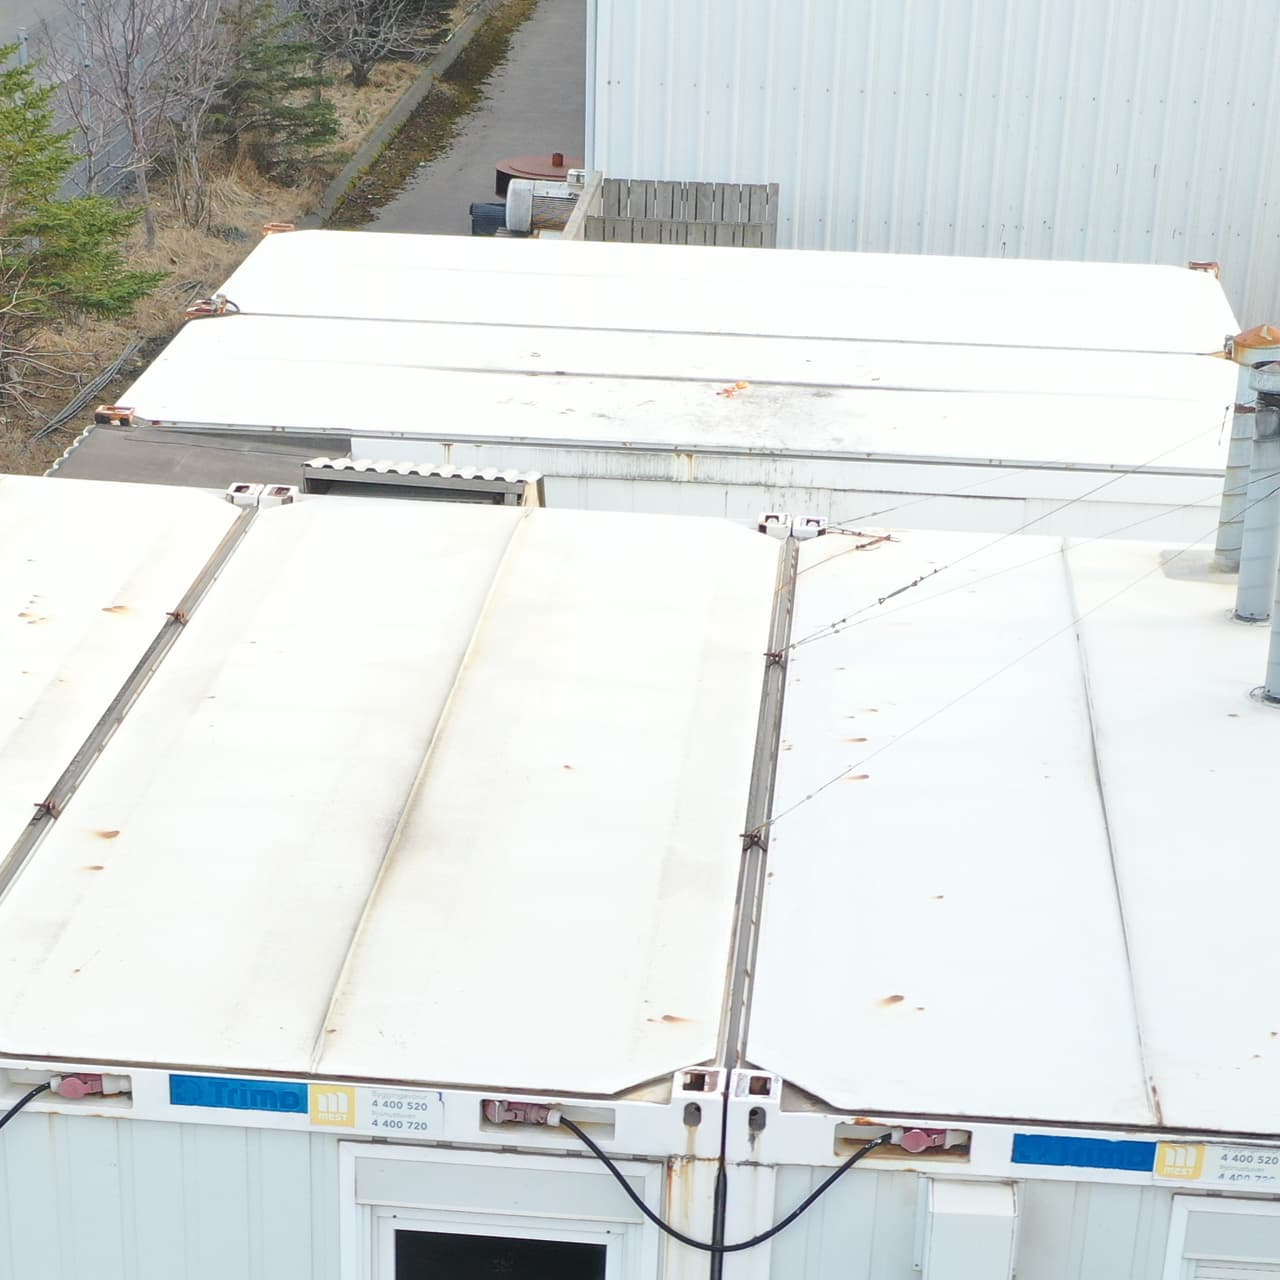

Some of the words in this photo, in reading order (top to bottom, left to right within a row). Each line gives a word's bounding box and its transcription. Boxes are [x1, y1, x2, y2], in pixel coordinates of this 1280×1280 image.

[371, 1099, 378, 1107] 4
[382, 1100, 403, 1109] 400
[407, 1102, 428, 1111] 520
[371, 1119, 378, 1127] 4
[382, 1120, 403, 1129] 400
[407, 1121, 428, 1130] 720
[1232, 1154, 1253, 1163] 400
[1257, 1156, 1279, 1165] 520
